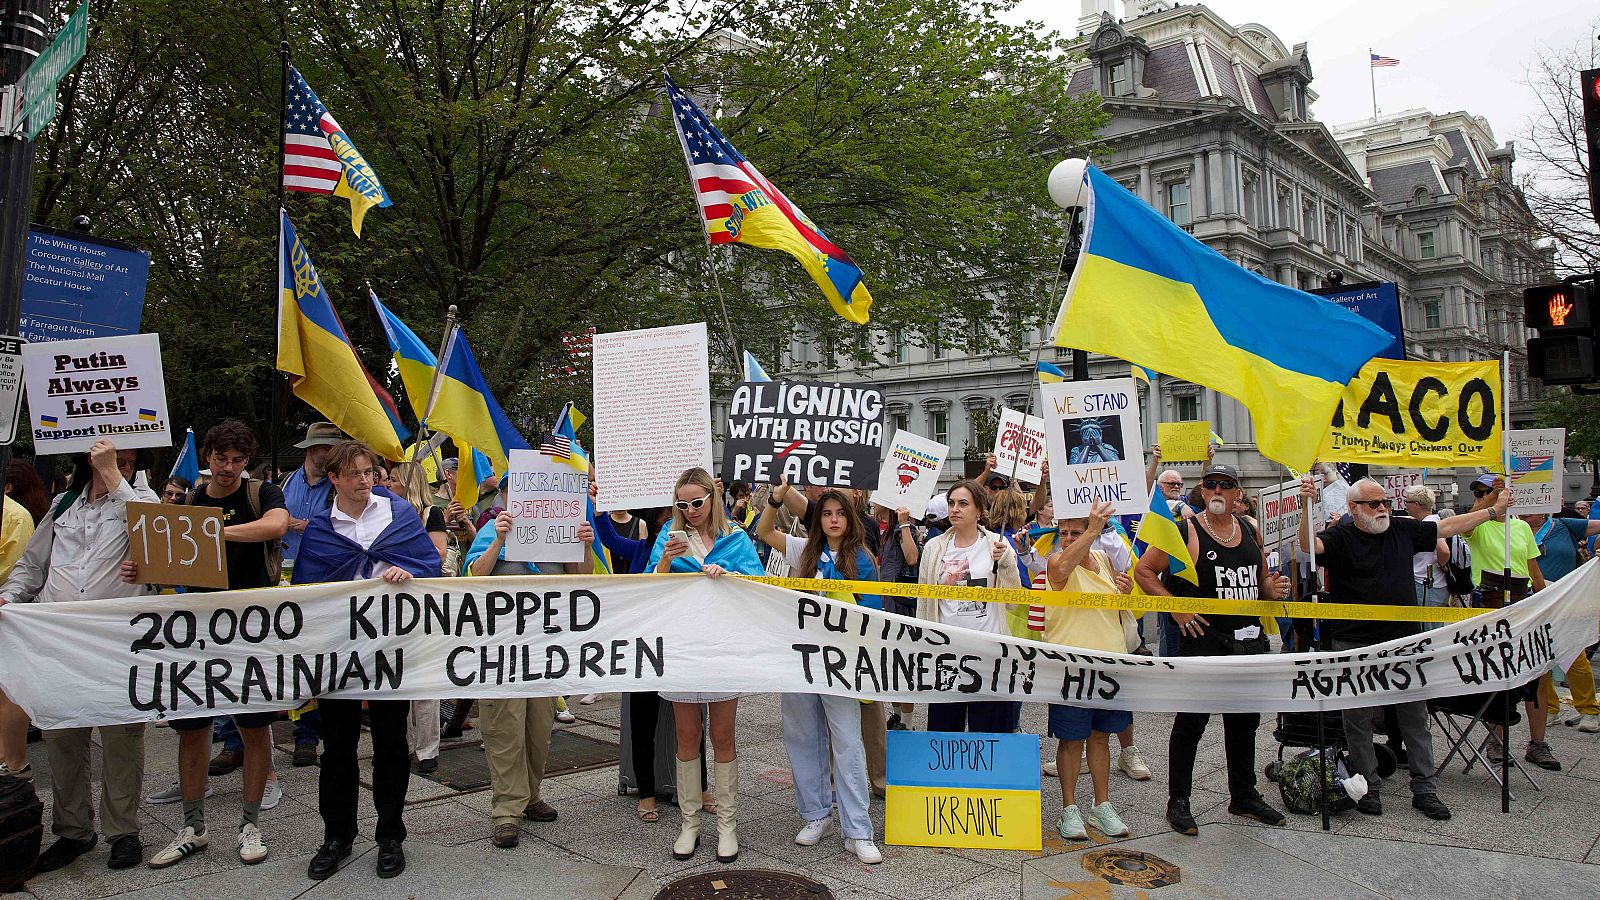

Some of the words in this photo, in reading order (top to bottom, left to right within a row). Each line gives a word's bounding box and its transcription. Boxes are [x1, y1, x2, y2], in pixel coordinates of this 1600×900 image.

[34, 236, 50, 246] The
[52, 240, 78, 252] White
[80, 244, 107, 258] House
[29, 261, 46, 271] The
[48, 265, 84, 278] National
[86, 271, 105, 282] Mall
[31, 249, 71, 263] Corcoran
[73, 257, 103, 271] Gallery
[105, 264, 115, 272] of
[115, 265, 129, 274] Art
[26, 274, 62, 287] Decatur
[64, 280, 92, 292] House
[1356, 293, 1365, 301] of
[1366, 292, 1378, 300] Art
[30, 320, 69, 333] Farragut
[70, 325, 95, 336] North
[54, 352, 127, 371] Putin
[48, 376, 139, 394] Always
[65, 396, 126, 416] Lies!
[731, 381, 883, 420] ALIGNING
[1054, 396, 1078, 415] WE
[1083, 392, 1128, 412] STAND
[35, 425, 96, 440] Support
[98, 421, 165, 434] Ukraine!
[728, 415, 788, 439] WITH
[793, 418, 882, 447] RUSSIA
[1189, 434, 1206, 442] OUT
[1511, 436, 1534, 446] EACE
[1332, 432, 1371, 451] Trump
[1372, 435, 1406, 453] Always
[1409, 441, 1453, 452] Chickens
[1512, 447, 1555, 457] STRENGTH
[893, 451, 910, 462] STILL
[911, 457, 937, 471] BLEEDS
[895, 444, 940, 465] UKRAINE
[1019, 458, 1037, 469] POINT
[733, 454, 854, 486] PEACE
[1074, 466, 1119, 484] WITH
[512, 472, 589, 494] UKRAINE
[1540, 484, 1555, 494] for
[1067, 483, 1132, 505] UKRAINE
[511, 500, 581, 519] DEFENDS
[132, 514, 222, 572] 1939
[516, 526, 538, 544] US
[545, 526, 581, 544] ALL
[129, 601, 303, 654] 20,000
[350, 589, 601, 639] KIDNAPPED
[1291, 656, 1435, 699] AGAINST
[1452, 622, 1555, 686] UKRAINE
[128, 647, 404, 719] UKRAINIAN
[446, 636, 665, 687] CHILDREN
[792, 643, 982, 693] TRAINEES
[991, 658, 1035, 695] IN
[1061, 665, 1120, 700] HIS
[928, 739, 999, 771] SUPPORT
[926, 796, 1003, 837] UKRAINE
